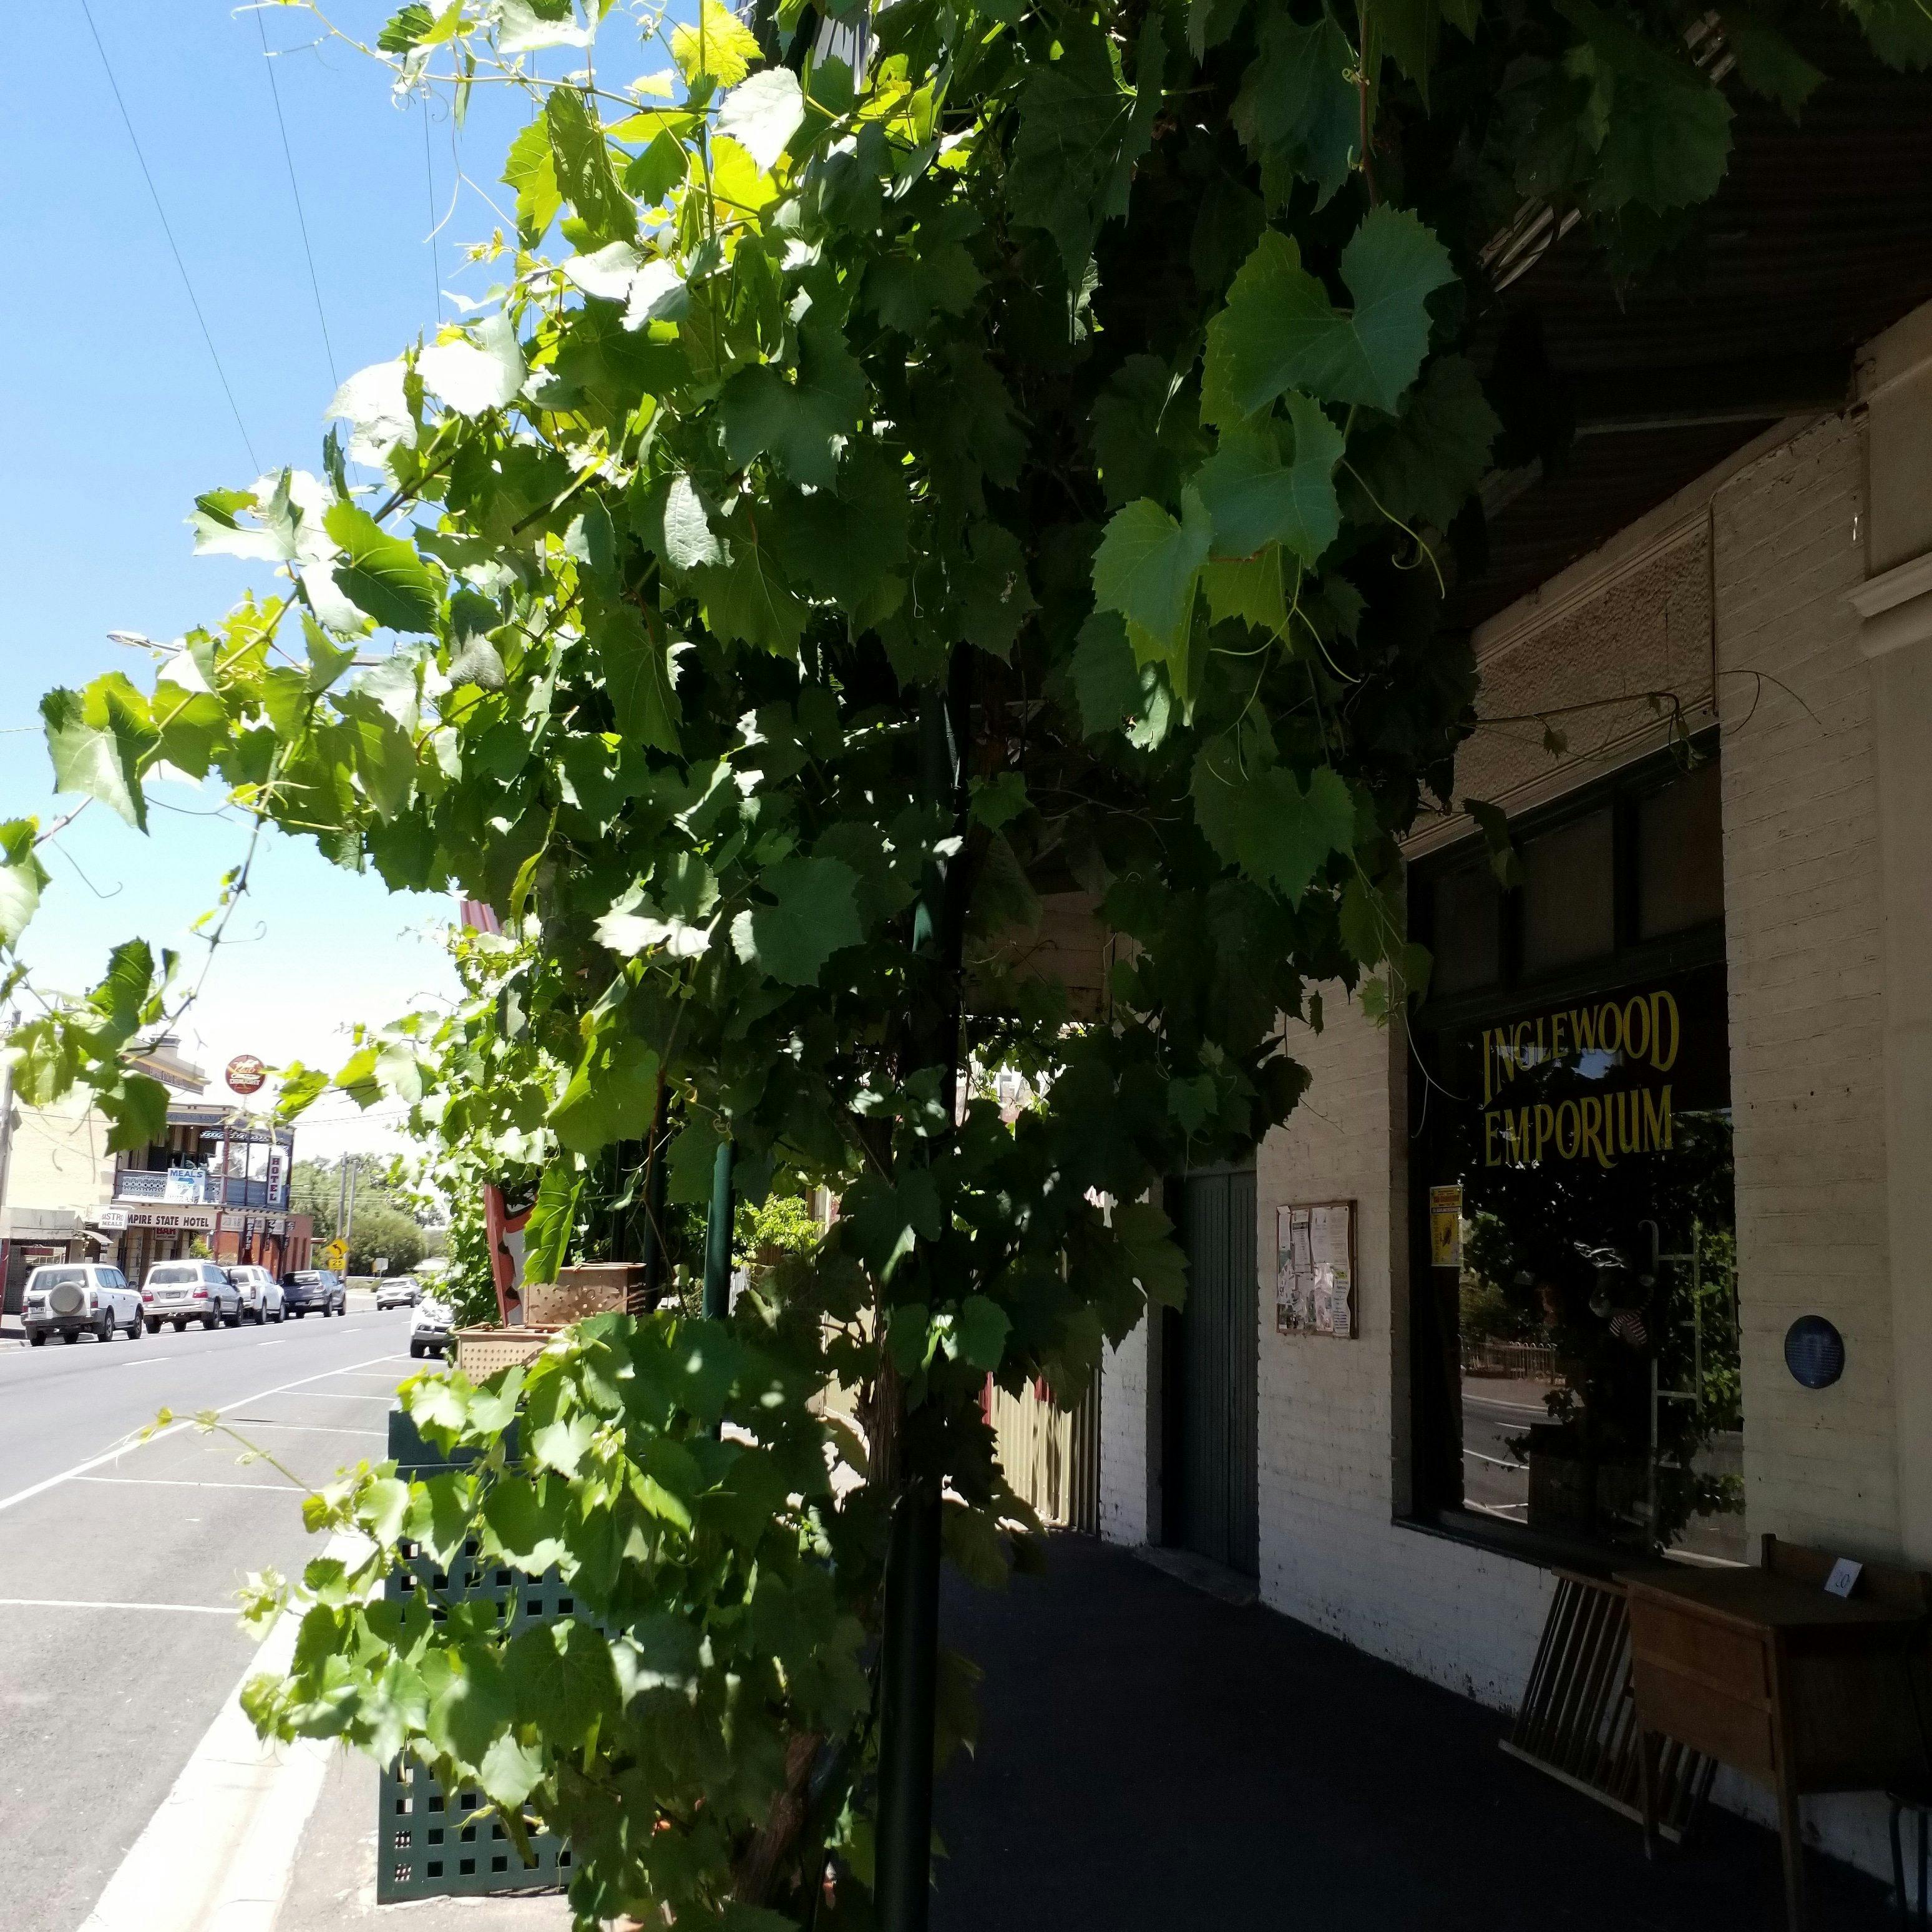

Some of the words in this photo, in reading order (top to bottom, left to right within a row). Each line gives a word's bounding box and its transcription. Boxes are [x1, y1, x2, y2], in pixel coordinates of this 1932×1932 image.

[1481, 990, 1680, 1108] INGLEWOOD
[1485, 1084, 1673, 1168] EMPORIUM
[170, 1169, 203, 1178] MEALS
[270, 1158, 280, 1201] HOTEL
[102, 1212, 124, 1221] BISTRO
[127, 1214, 152, 1225] MPIRE
[155, 1215, 179, 1226] STATE
[183, 1216, 209, 1227] HOTEL
